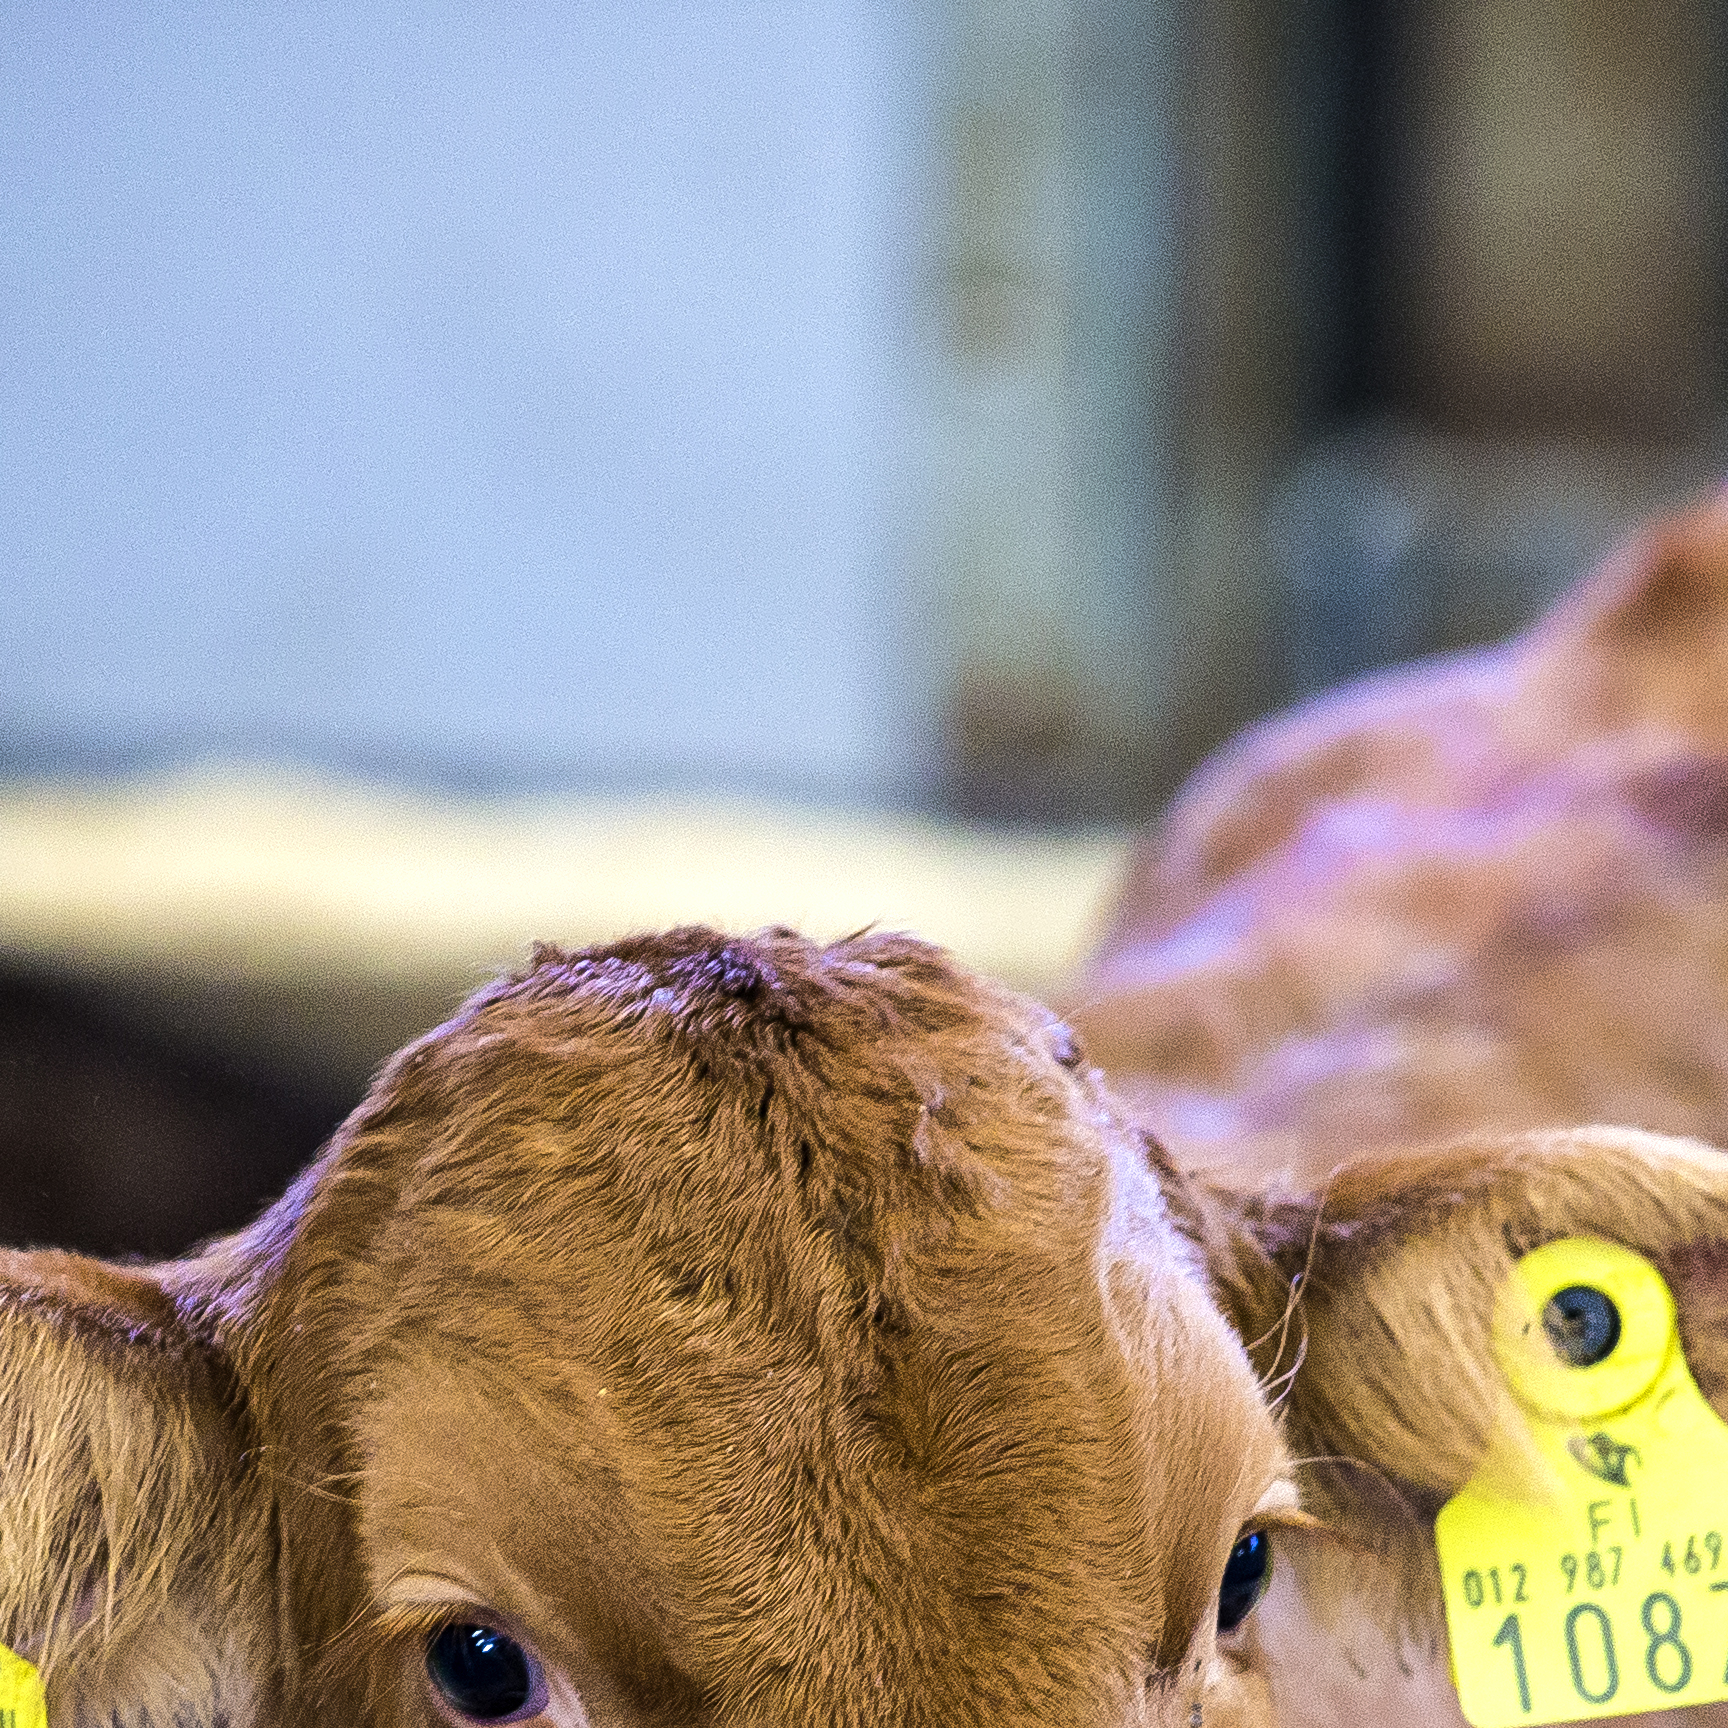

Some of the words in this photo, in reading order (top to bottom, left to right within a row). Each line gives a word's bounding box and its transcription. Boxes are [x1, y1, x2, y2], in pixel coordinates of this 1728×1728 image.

[1588, 1497, 1641, 1544] FI
[1462, 1563, 1530, 1608] 012
[1560, 1545, 1623, 1594] 987
[1661, 1531, 1722, 1577] 469
